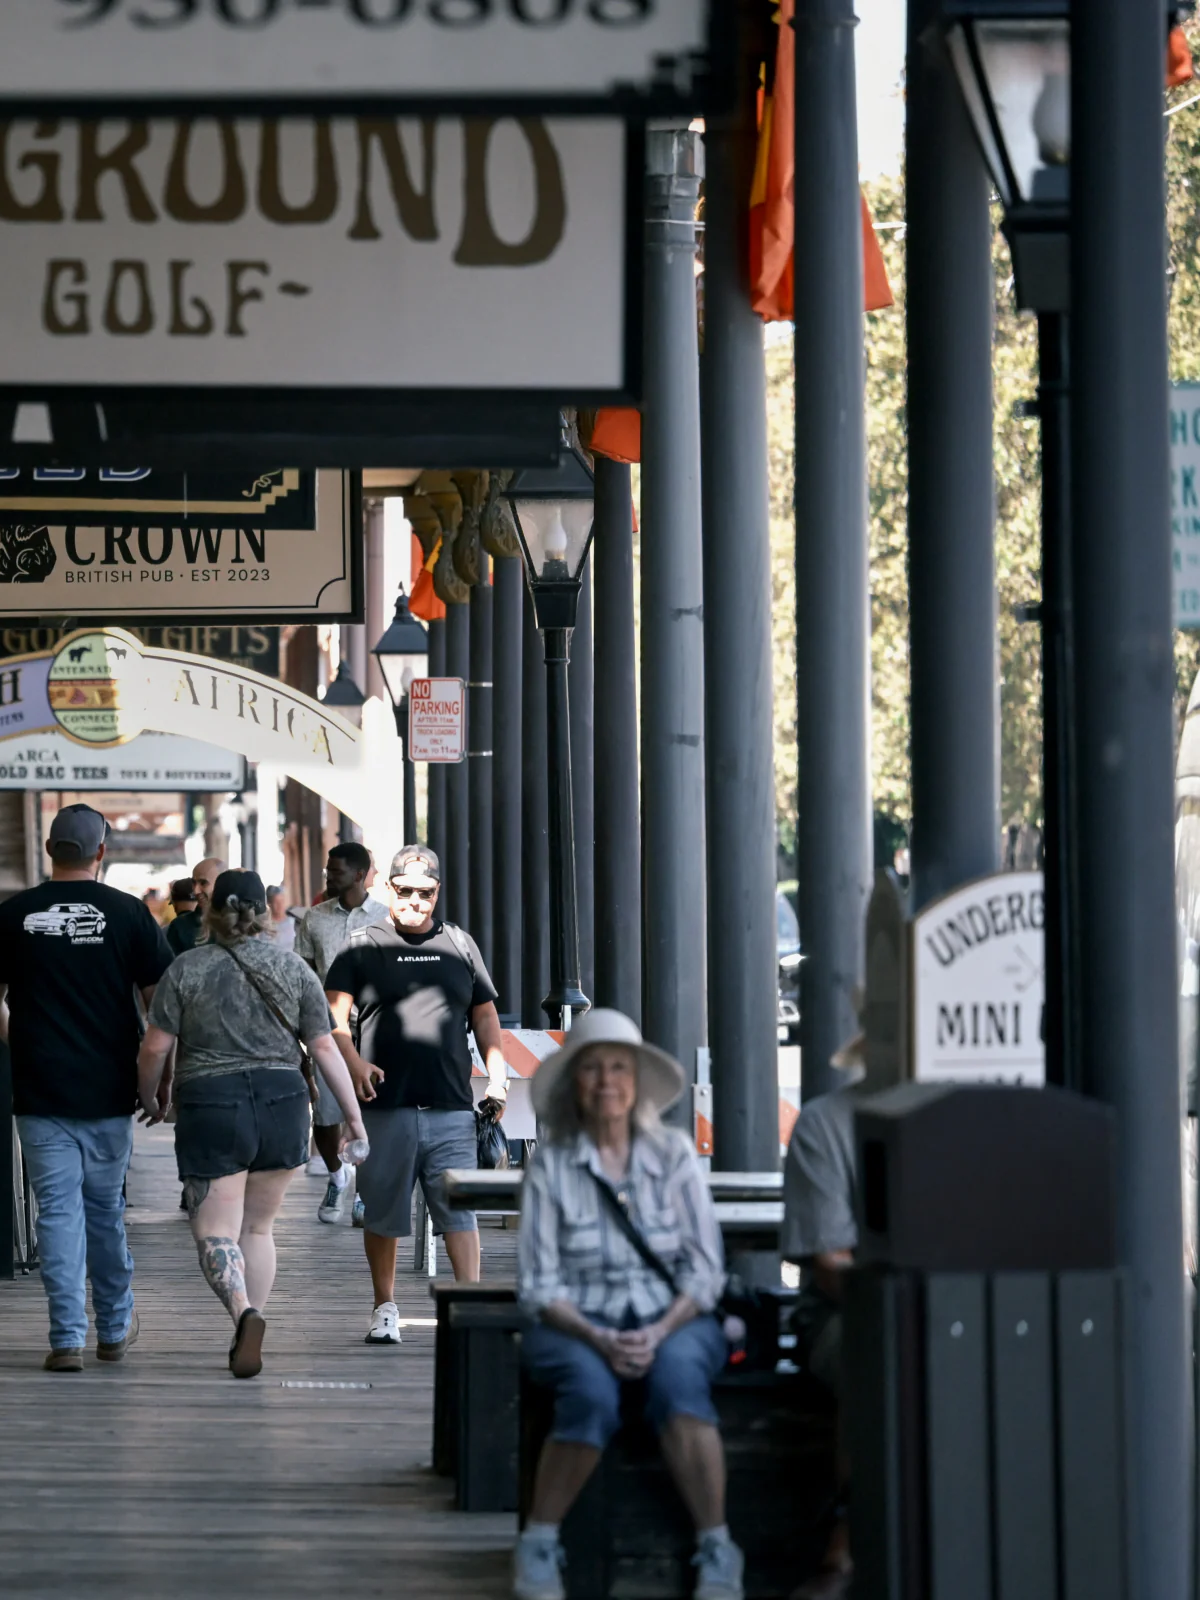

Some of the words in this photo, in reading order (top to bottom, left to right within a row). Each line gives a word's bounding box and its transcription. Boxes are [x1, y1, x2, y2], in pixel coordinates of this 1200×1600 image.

[63, 524, 267, 566] CROWN
[65, 570, 133, 584] BRITISH
[140, 570, 174, 583] PUB
[191, 569, 221, 582] EST
[227, 568, 271, 582] 2023
[162, 626, 270, 656] GIFTS
[412, 681, 430, 698] NO
[414, 701, 460, 715] PARKING
[35, 766, 65, 779] SAC
[73, 766, 109, 780] TEES
[937, 1002, 1021, 1048] MINI
